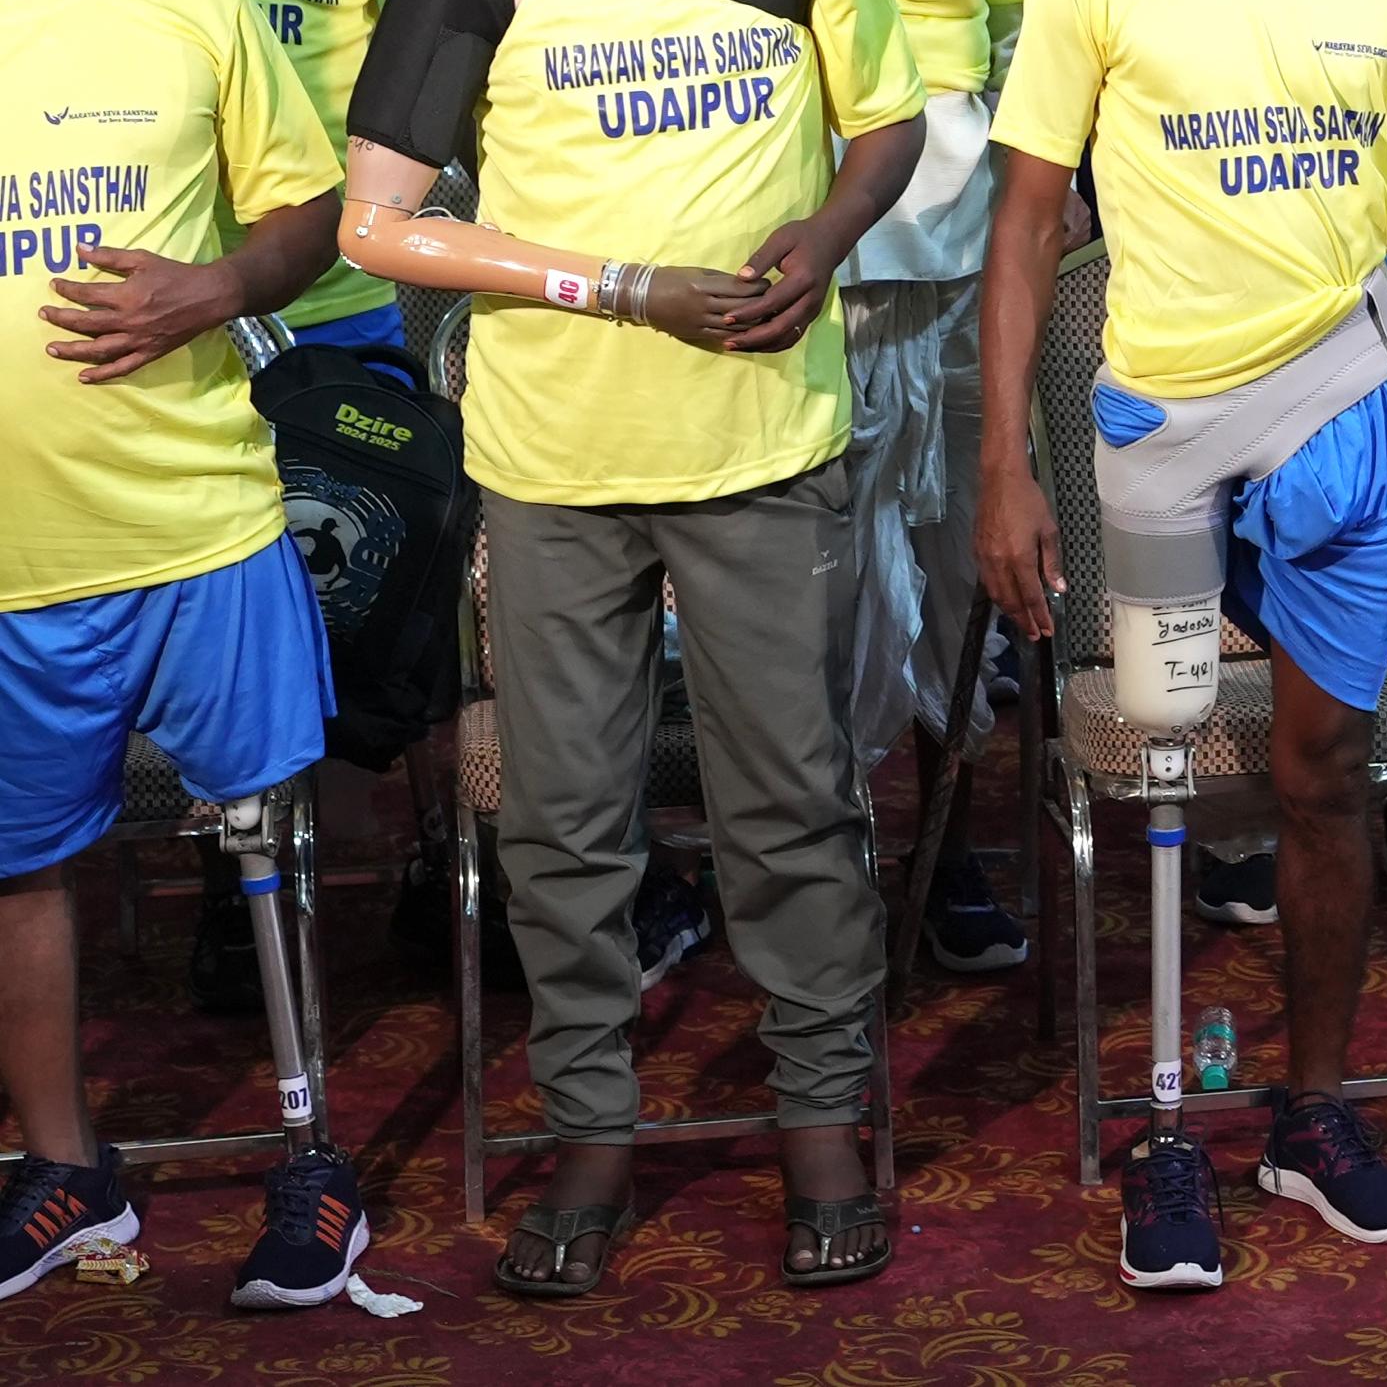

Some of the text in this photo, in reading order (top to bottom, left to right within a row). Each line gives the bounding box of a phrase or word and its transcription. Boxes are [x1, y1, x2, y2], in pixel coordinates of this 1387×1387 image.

[544, 39, 646, 92] NARAYAN
[652, 34, 708, 80] SEVA
[597, 76, 775, 140] UDAIPUR
[1159, 110, 1259, 151] NARAYAN
[1265, 106, 1310, 145] SEVA
[29, 164, 149, 220] SANSTHAN
[1219, 149, 1360, 197] UDAIPUR
[335, 402, 414, 443] Dzire
[335, 423, 401, 452] 2024 2025
[279, 1086, 308, 1110] 207
